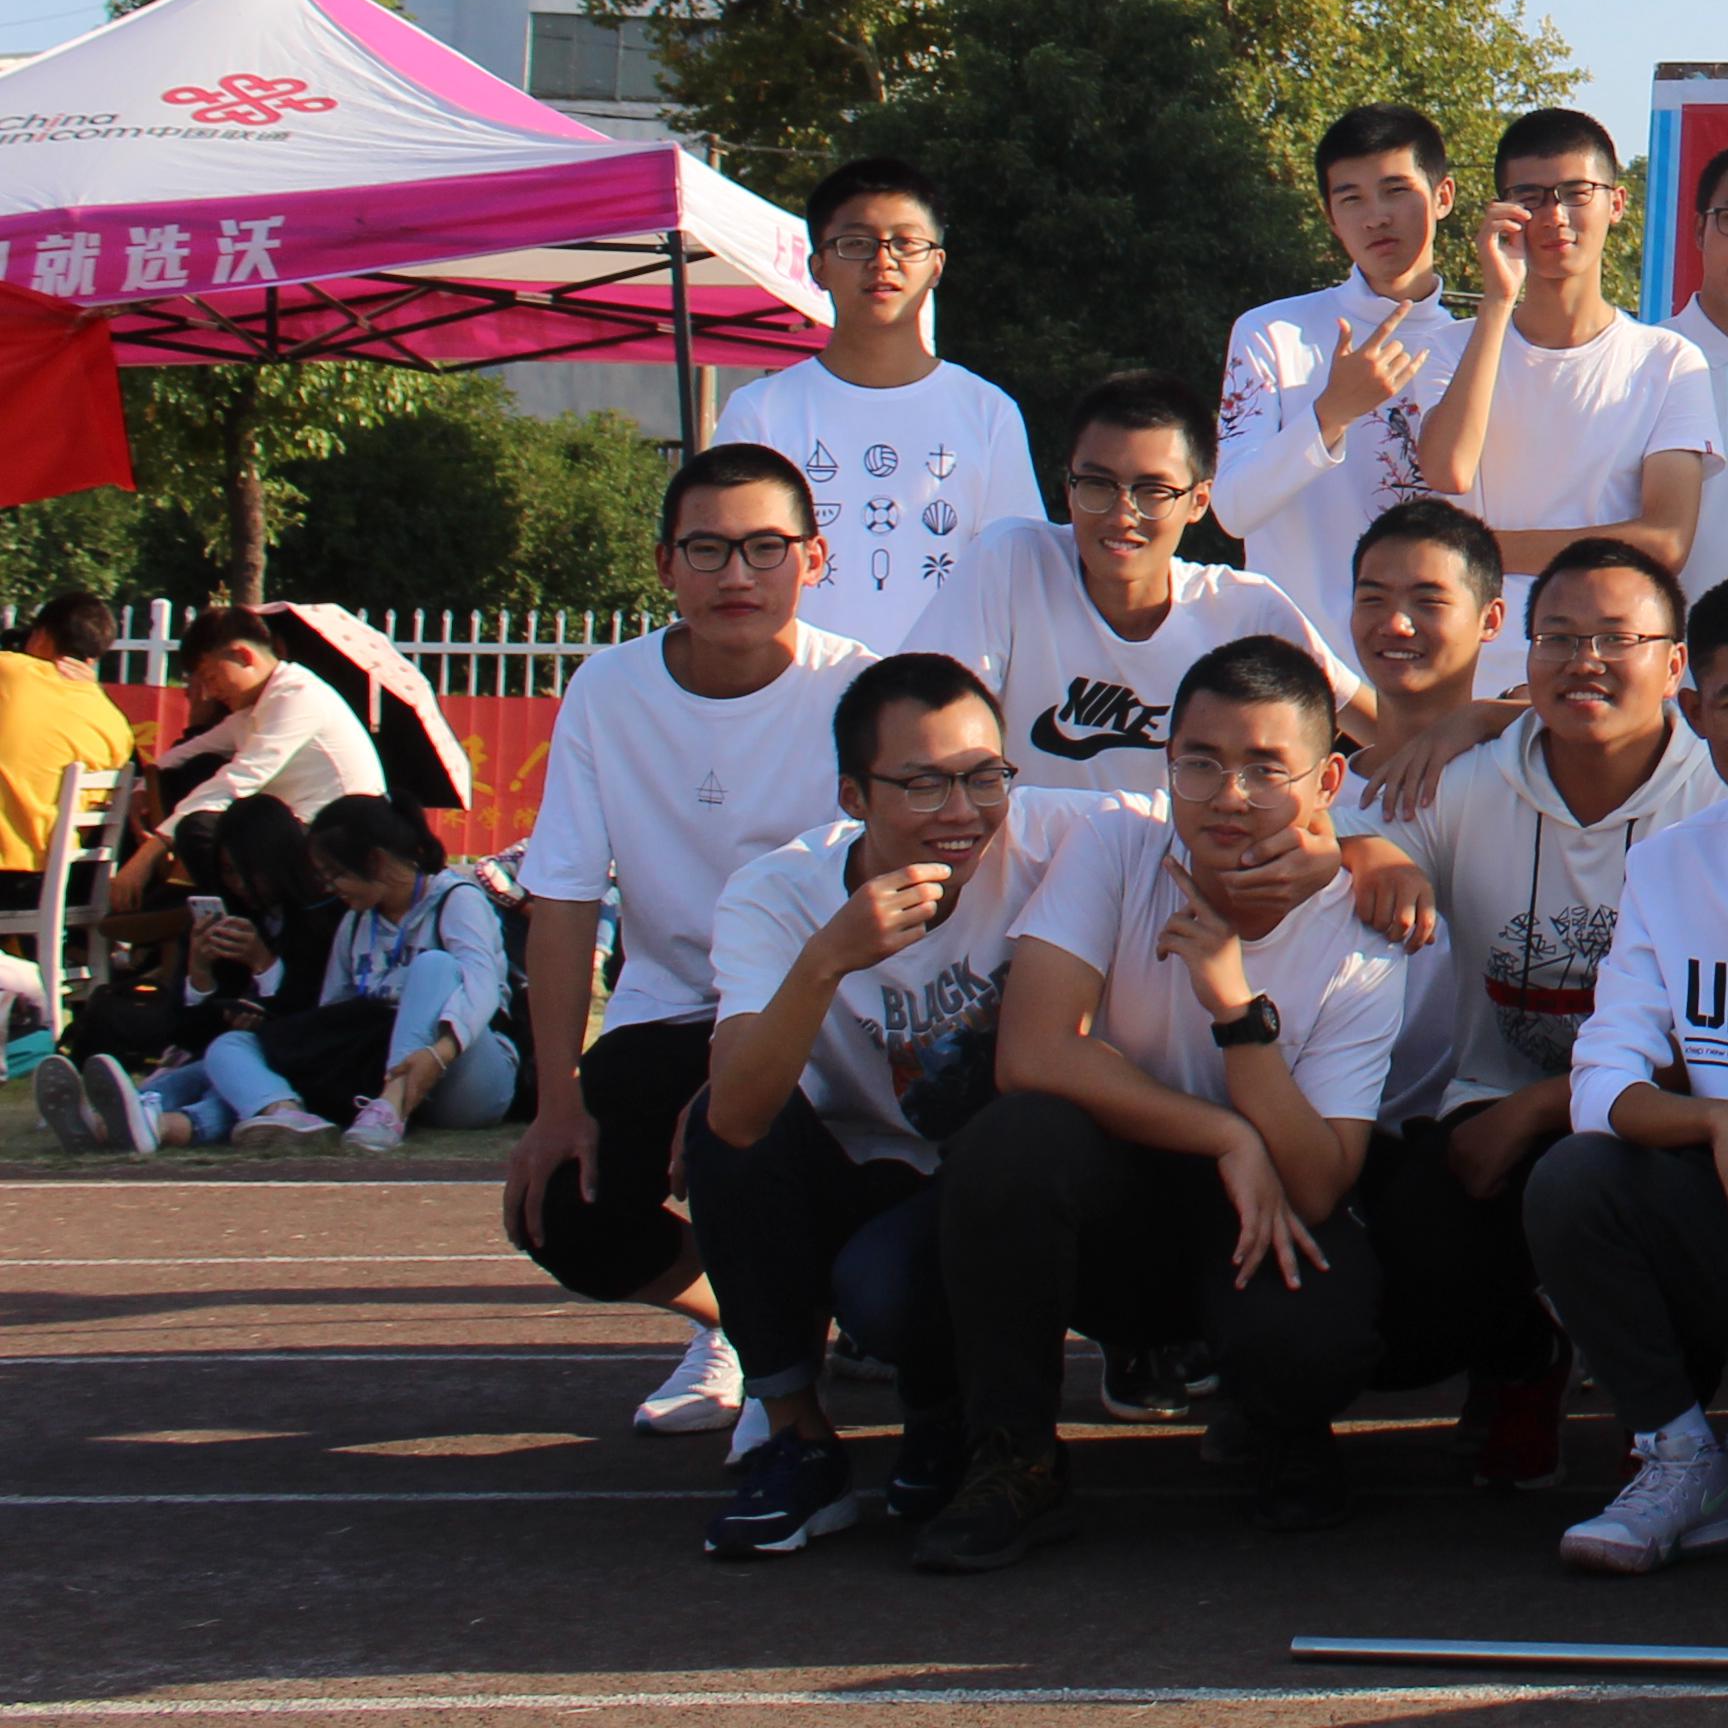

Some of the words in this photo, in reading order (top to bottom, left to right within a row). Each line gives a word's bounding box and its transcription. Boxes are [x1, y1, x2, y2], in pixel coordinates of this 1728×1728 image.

[0, 215, 286, 297] 就选沃
[1058, 676, 1171, 736] NIKE
[881, 953, 993, 1033] BLACK
